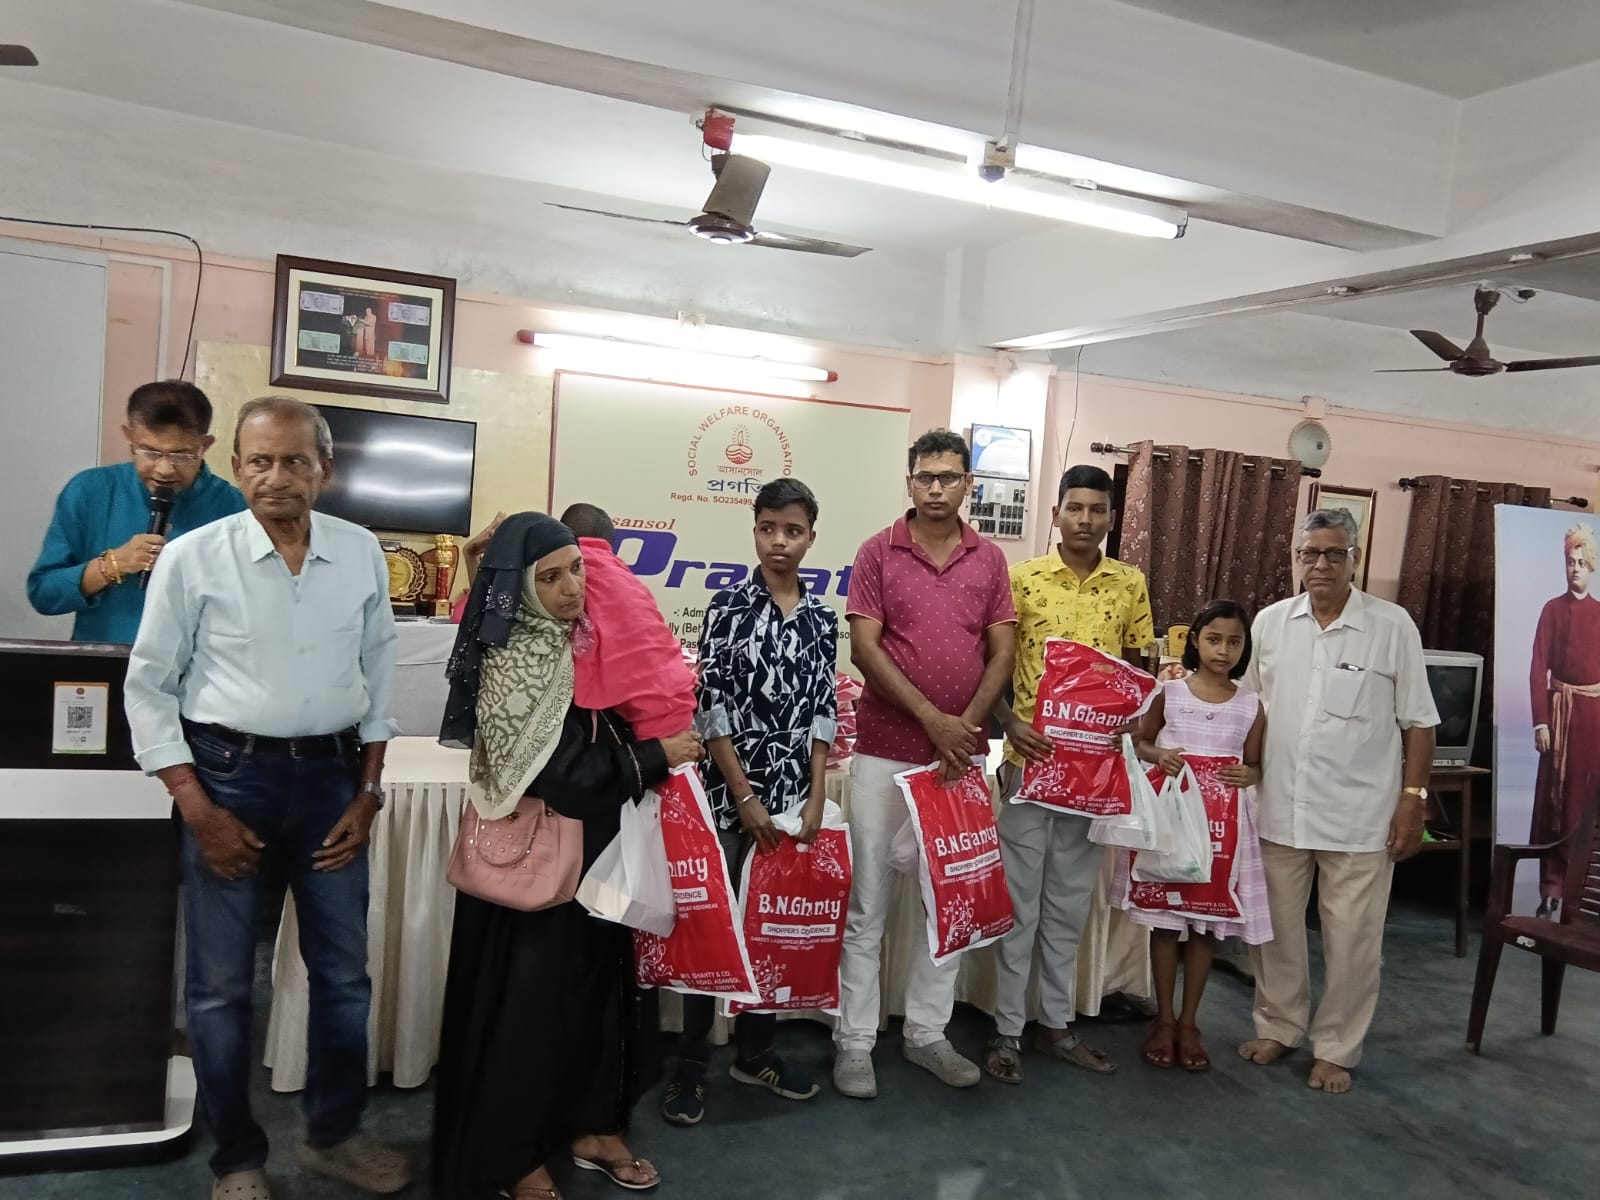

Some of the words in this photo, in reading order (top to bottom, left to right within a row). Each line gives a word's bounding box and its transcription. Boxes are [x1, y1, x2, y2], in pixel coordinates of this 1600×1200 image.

[687, 434, 702, 477] SOCIAL
[698, 405, 750, 432] WELFARE
[752, 409, 793, 476] ORGANISATIO
[612, 518, 676, 530] sansol
[680, 638, 699, 649] Pas
[1209, 820, 1225, 838] ty
[758, 893, 840, 920] B.N.Ghnty
